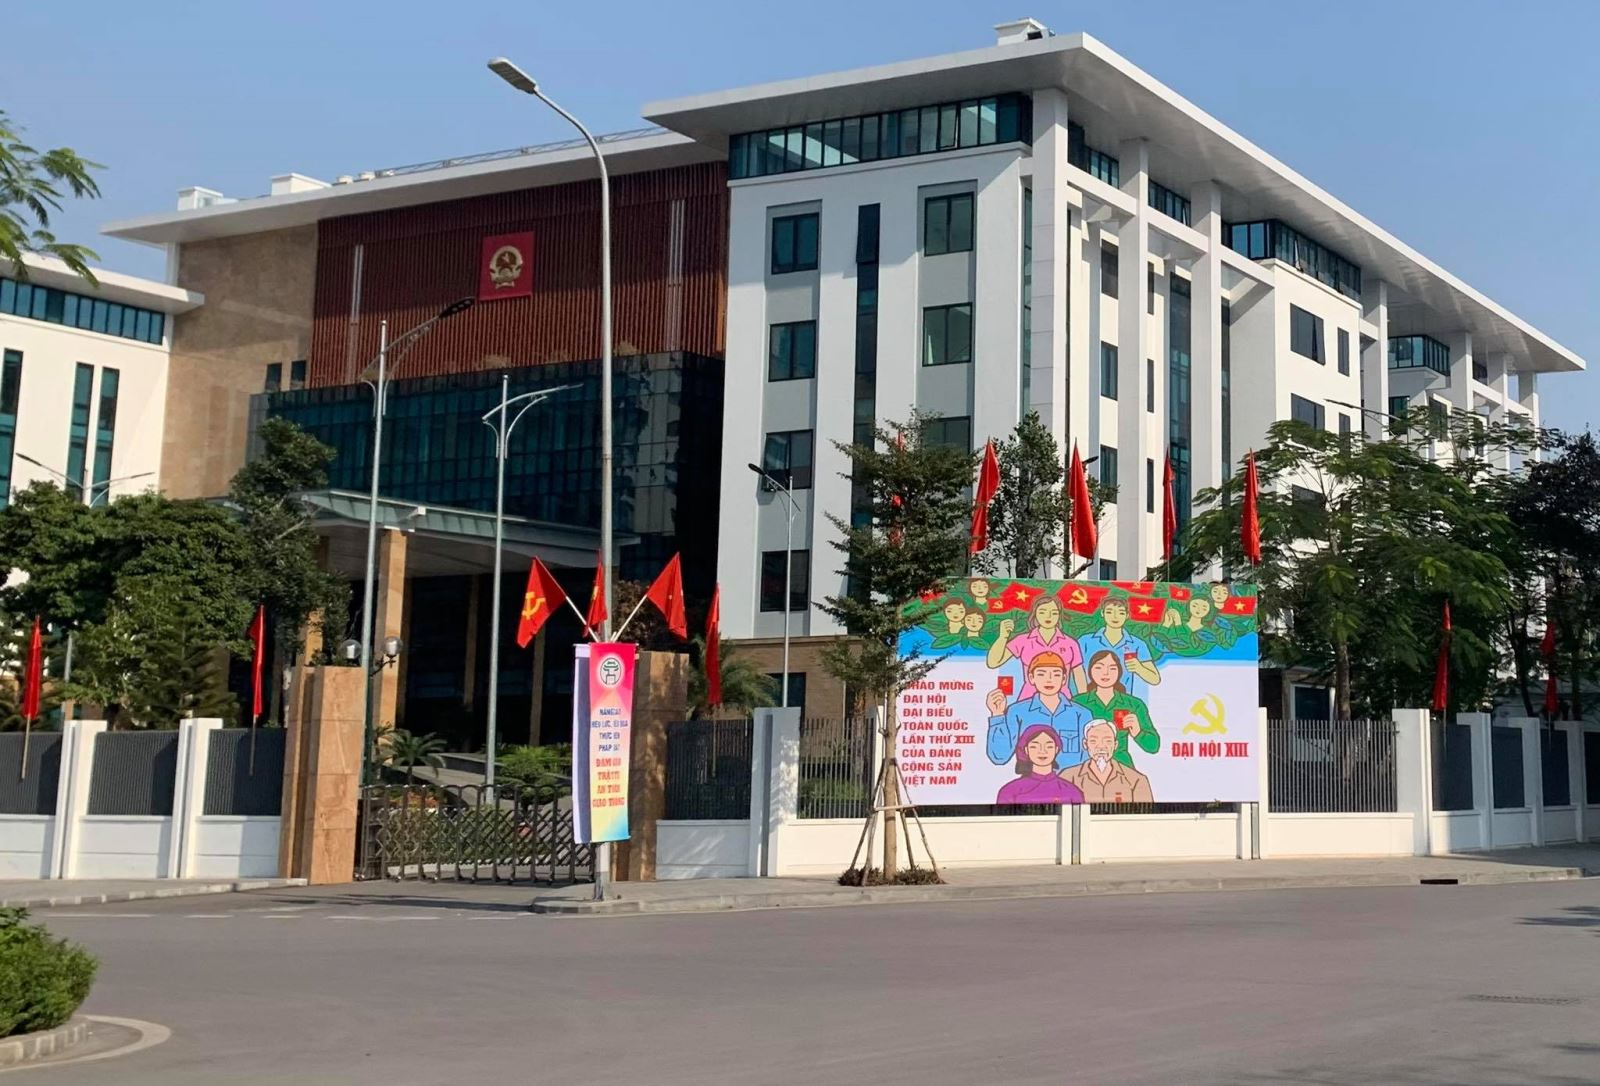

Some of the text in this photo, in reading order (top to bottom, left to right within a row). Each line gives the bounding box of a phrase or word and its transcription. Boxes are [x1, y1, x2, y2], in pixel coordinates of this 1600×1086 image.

[940, 678, 974, 690] MỪNG
[903, 692, 946, 706] ĐẠI HỘI
[903, 705, 953, 719] ĐẠI BIỂU
[902, 718, 969, 731] TOÀN QUỐC
[902, 732, 975, 744] LẦN THỨ XIII
[902, 745, 962, 758] CỦA ĐẢNG
[1171, 739, 1249, 760] ĐẠI HỘI XIII
[901, 759, 962, 773] CỘNG SẢN
[929, 775, 957, 785] NAM
